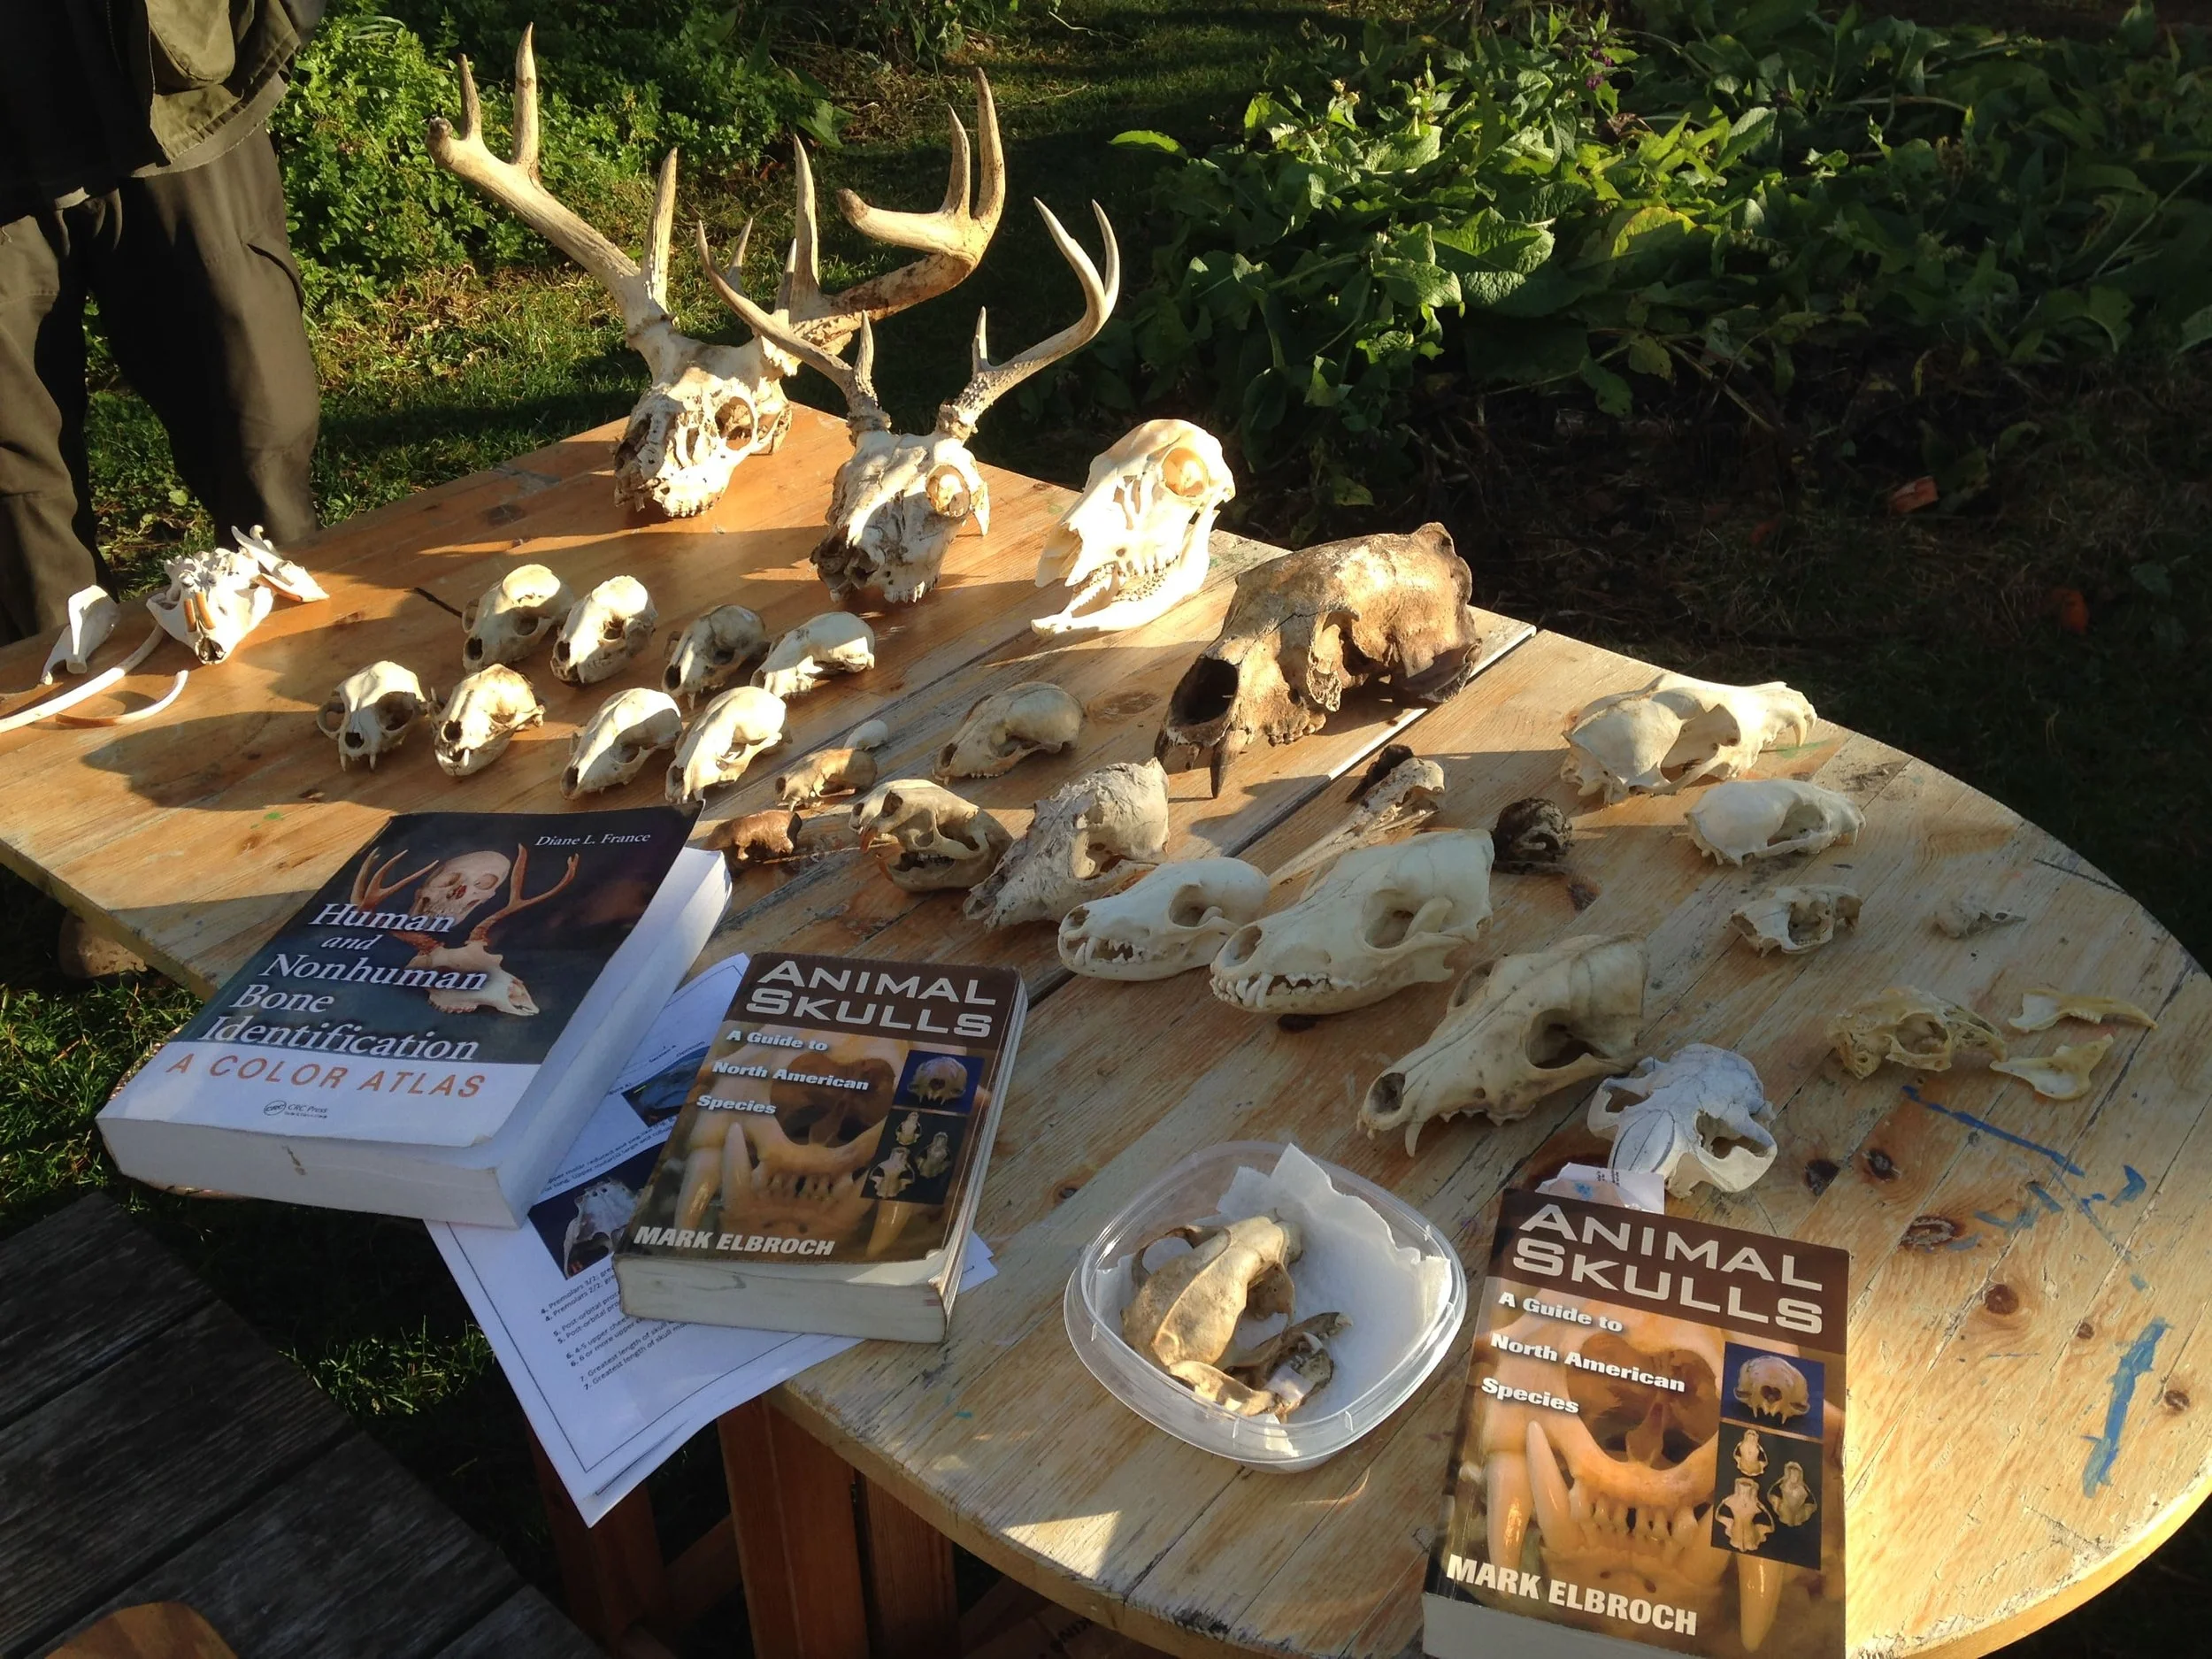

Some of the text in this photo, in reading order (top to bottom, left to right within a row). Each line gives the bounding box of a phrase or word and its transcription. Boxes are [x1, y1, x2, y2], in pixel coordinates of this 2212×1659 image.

[534, 833, 651, 846] Diane L. France
[308, 902, 456, 933] Human
[320, 934, 383, 951] and
[258, 954, 488, 991] Nonhuman
[757, 960, 996, 1005] ANIMAL
[229, 984, 334, 1013] Bone
[746, 987, 993, 1038] SKULLS
[197, 1016, 480, 1061] Identification
[726, 1030, 828, 1051] A Guide to
[165, 1053, 486, 1098] A COLOR ATLAS
[711, 1061, 870, 1091] North American
[696, 1095, 776, 1115] Species
[634, 1226, 835, 1256] MARK ELBROCH
[1519, 1203, 1823, 1292] ANIMAL
[549, 1285, 584, 1309] Premolars
[1513, 1237, 1823, 1334] SKULLS
[553, 1292, 588, 1316] Premolars
[562, 1302, 602, 1331] Post-orbital
[1498, 1292, 1623, 1333] A Guide to
[565, 1310, 606, 1338] Post-orbital
[588, 1329, 608, 1345] upper
[595, 1336, 613, 1351] more
[614, 1322, 634, 1338] upper
[588, 1354, 618, 1376] Greatest
[618, 1339, 641, 1356] length
[642, 1332, 649, 1340] of
[592, 1361, 623, 1384] Greatest
[623, 1347, 647, 1363] length
[656, 1330, 672, 1342] skull
[1490, 1333, 1686, 1393] North American
[1481, 1378, 1579, 1414] Species
[1446, 1554, 1697, 1636] MARK ELBROCH
